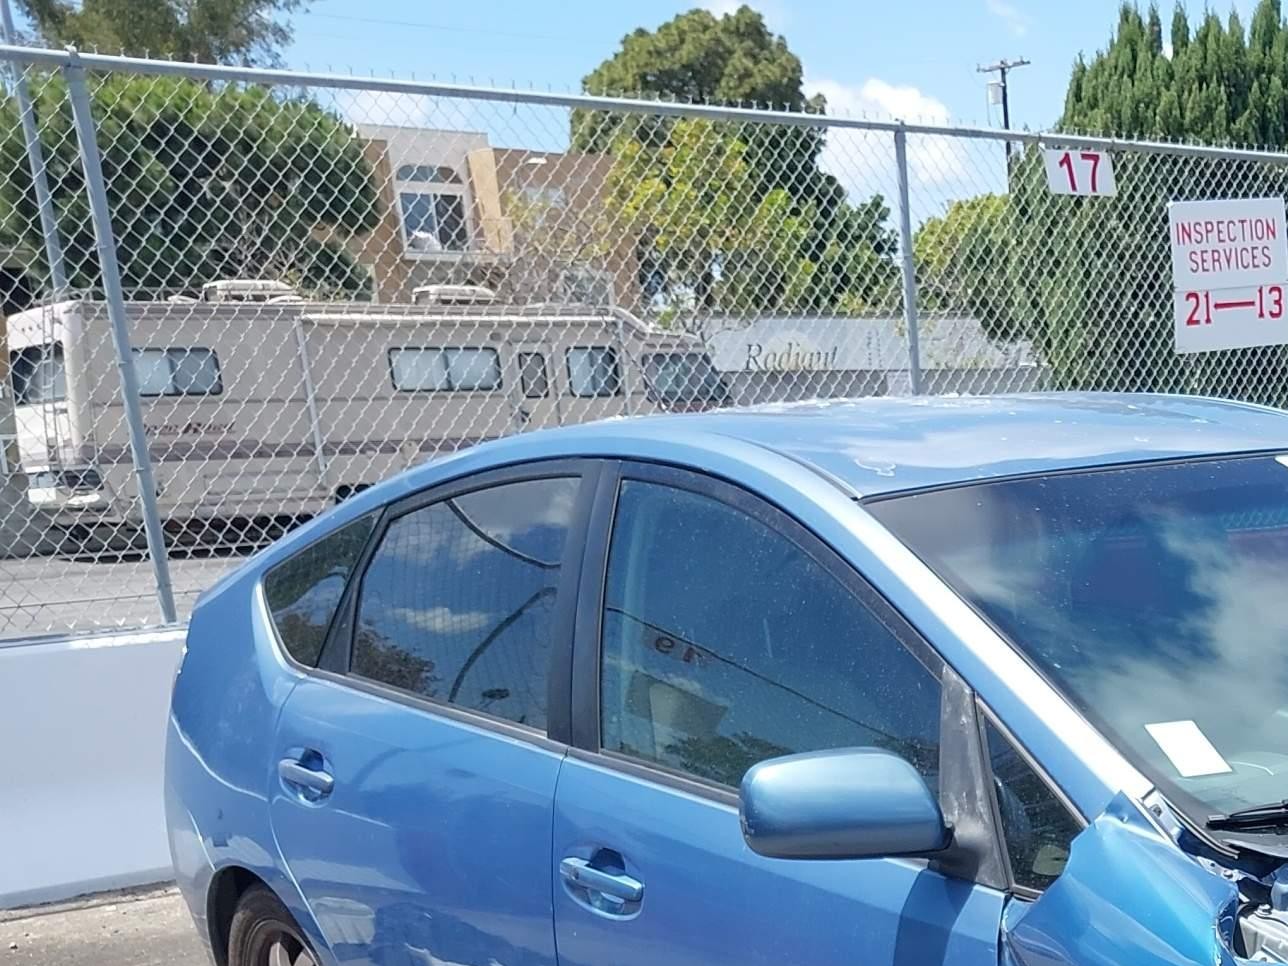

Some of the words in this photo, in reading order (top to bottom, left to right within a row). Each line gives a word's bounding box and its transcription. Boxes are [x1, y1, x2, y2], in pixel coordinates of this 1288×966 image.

[1058, 152, 1101, 194] 17
[1176, 218, 1276, 246] INSPECTION
[1189, 246, 1272, 273] SERVICES
[744, 342, 838, 371] Radiant
